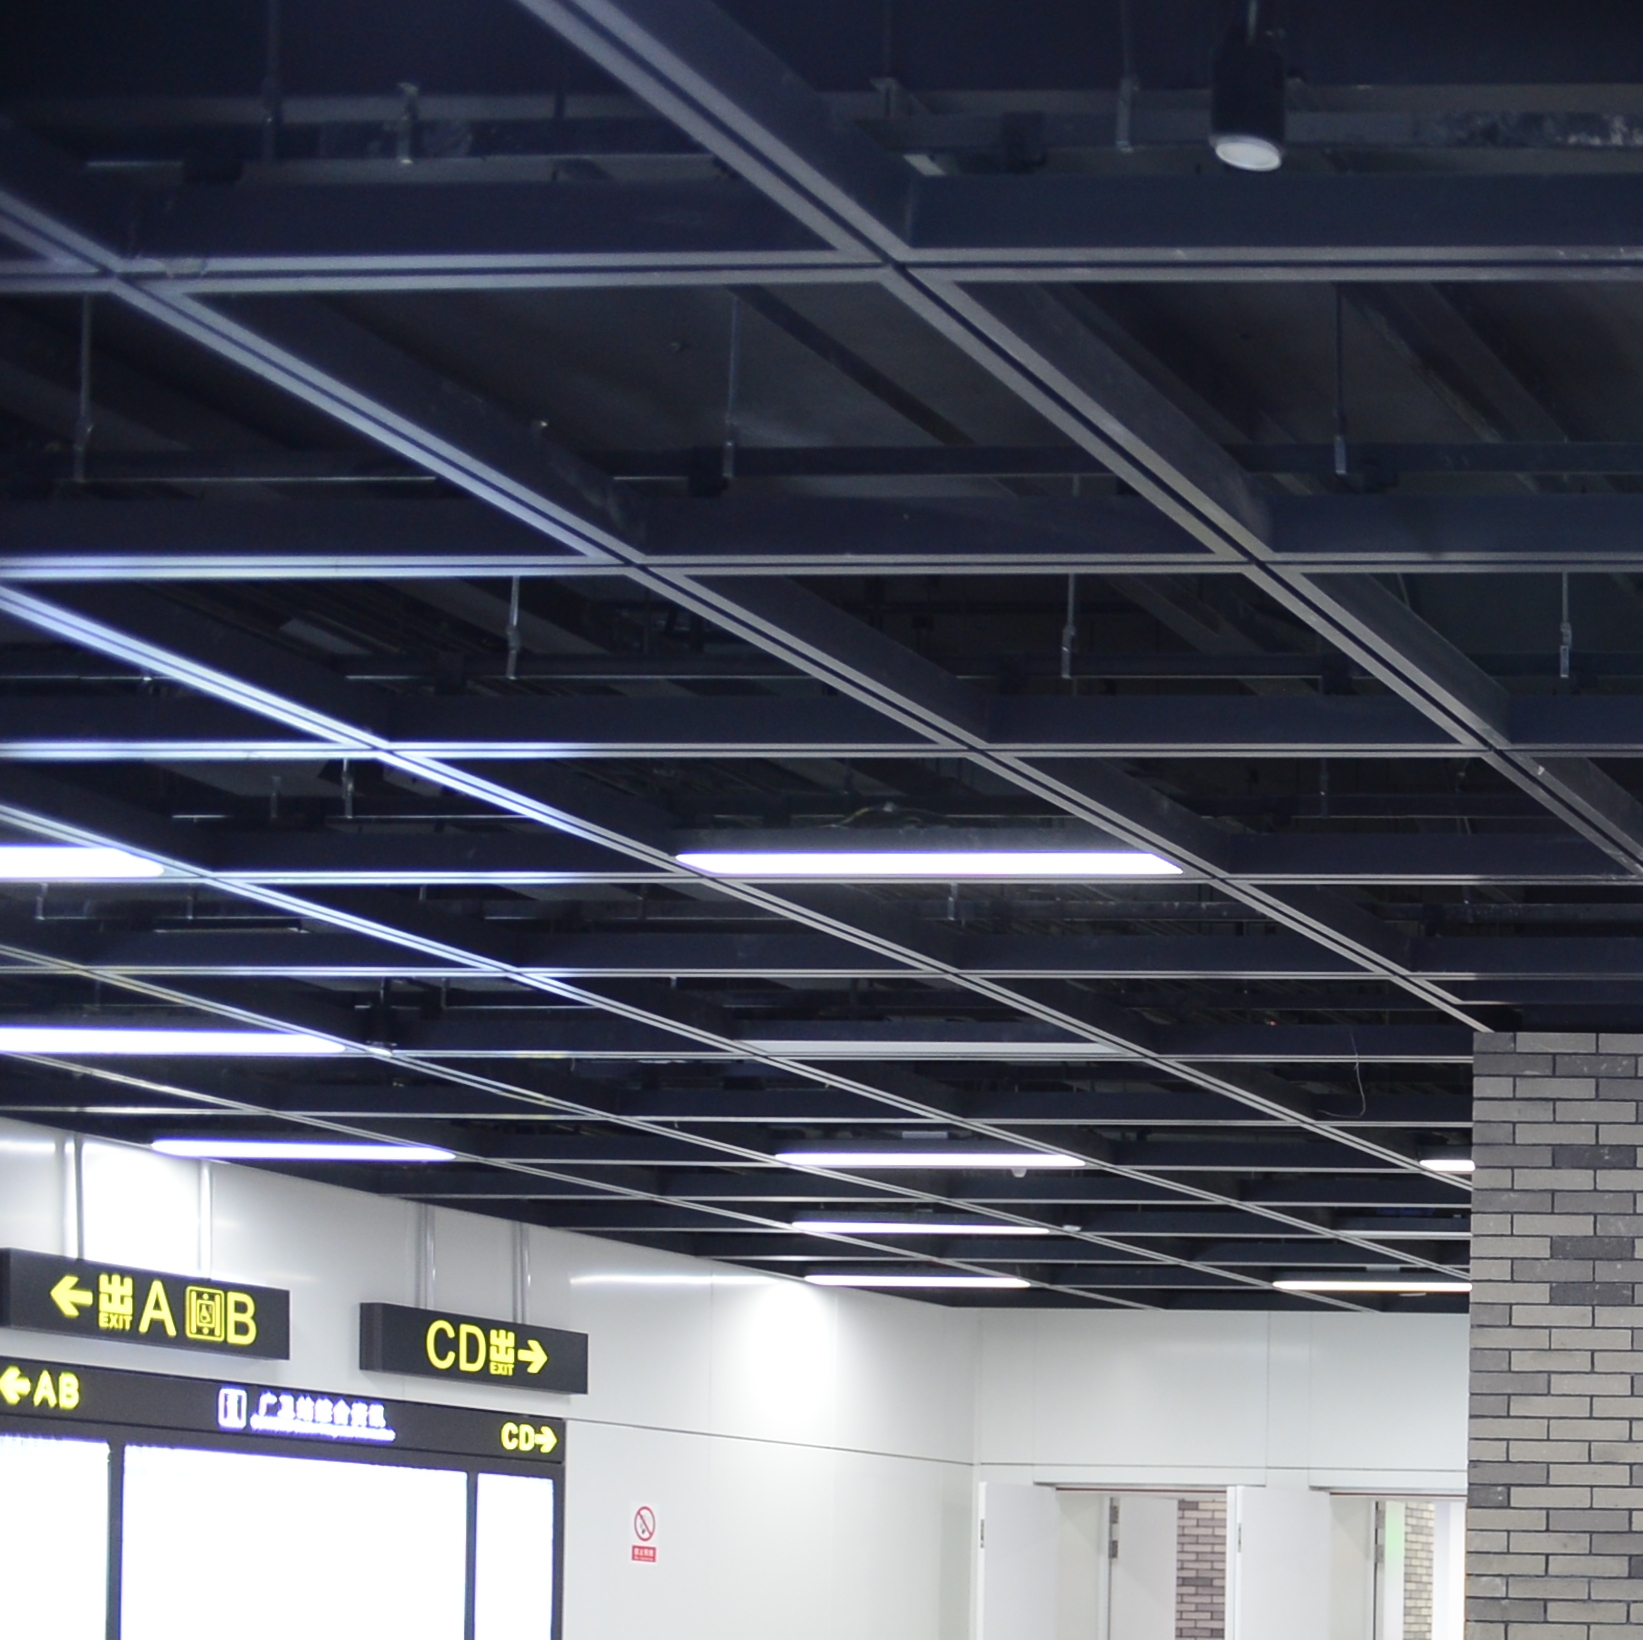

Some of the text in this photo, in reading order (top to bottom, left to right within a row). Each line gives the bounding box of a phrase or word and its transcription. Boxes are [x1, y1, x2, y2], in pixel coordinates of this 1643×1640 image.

[98, 1273, 258, 1345] 出 A B
[98, 1310, 133, 1332] EXIT
[426, 1320, 516, 1372] CD 出
[489, 1360, 515, 1377] EXIT
[33, 1369, 80, 1410] AB
[501, 1422, 536, 1451] CD
